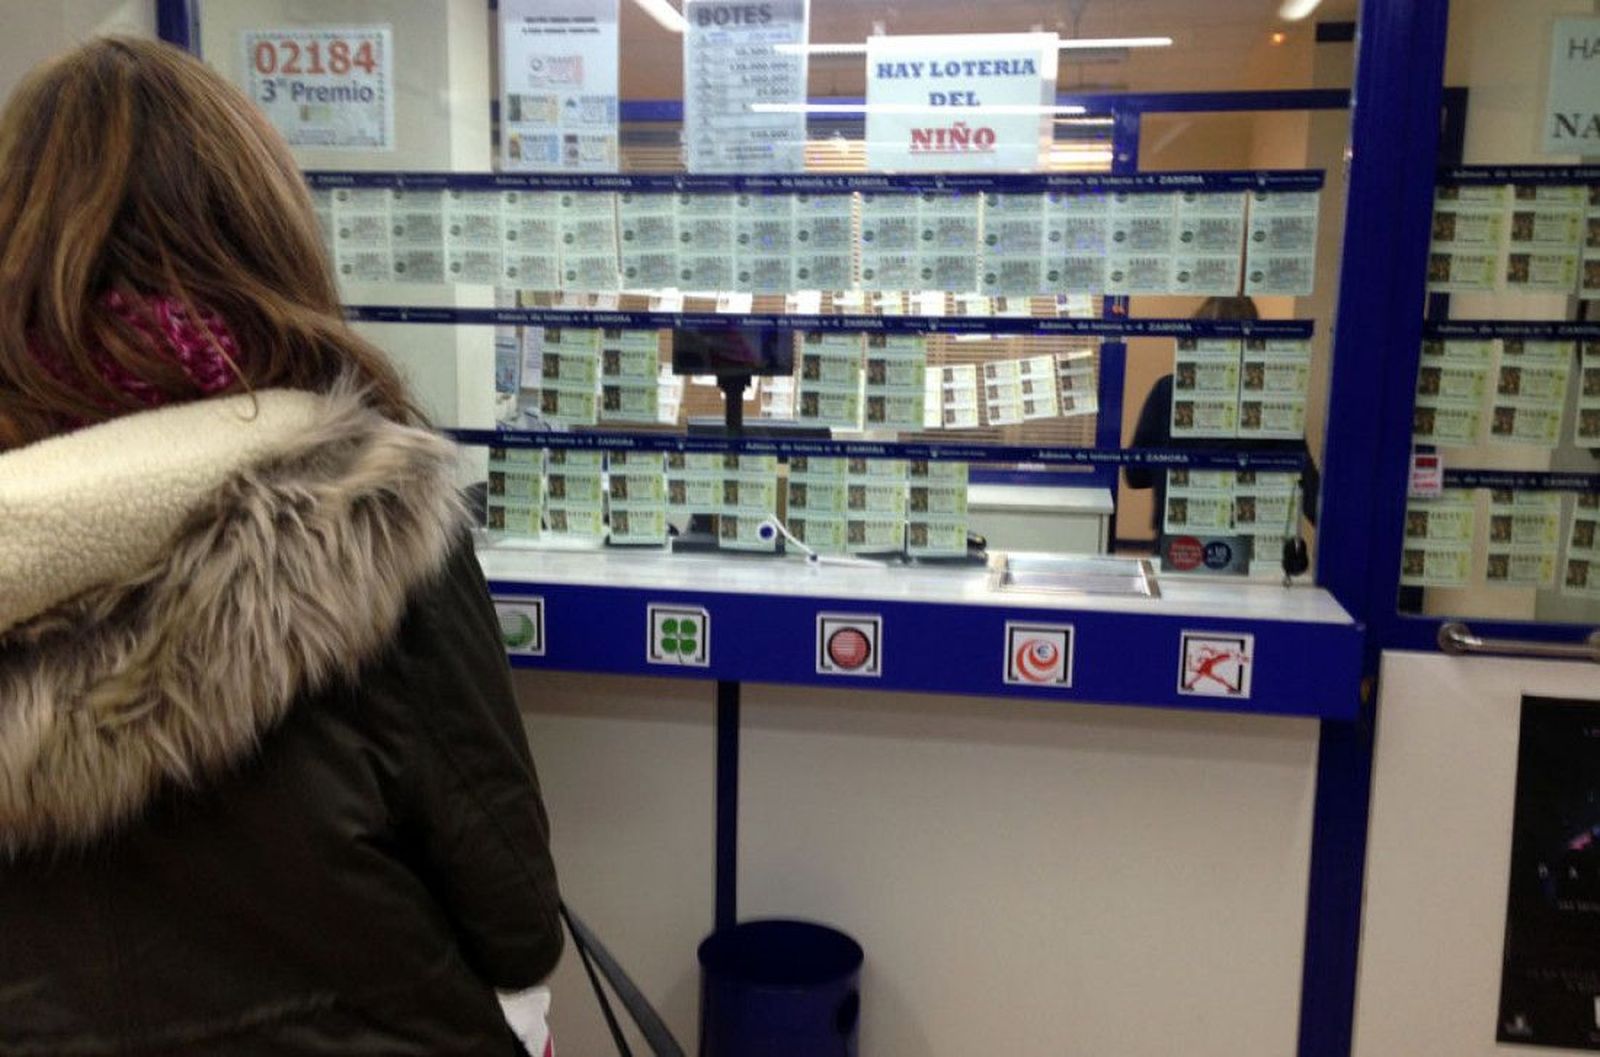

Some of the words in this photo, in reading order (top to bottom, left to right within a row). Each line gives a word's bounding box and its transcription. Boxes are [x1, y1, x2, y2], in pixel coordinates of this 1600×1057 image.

[697, 3, 772, 26] BOTES
[255, 40, 377, 75] 02184
[877, 62, 925, 79] HAY
[929, 58, 1036, 77] LOTERIA
[291, 80, 374, 102] Premio
[929, 91, 981, 107] DEL
[910, 122, 996, 150] NIÑO
